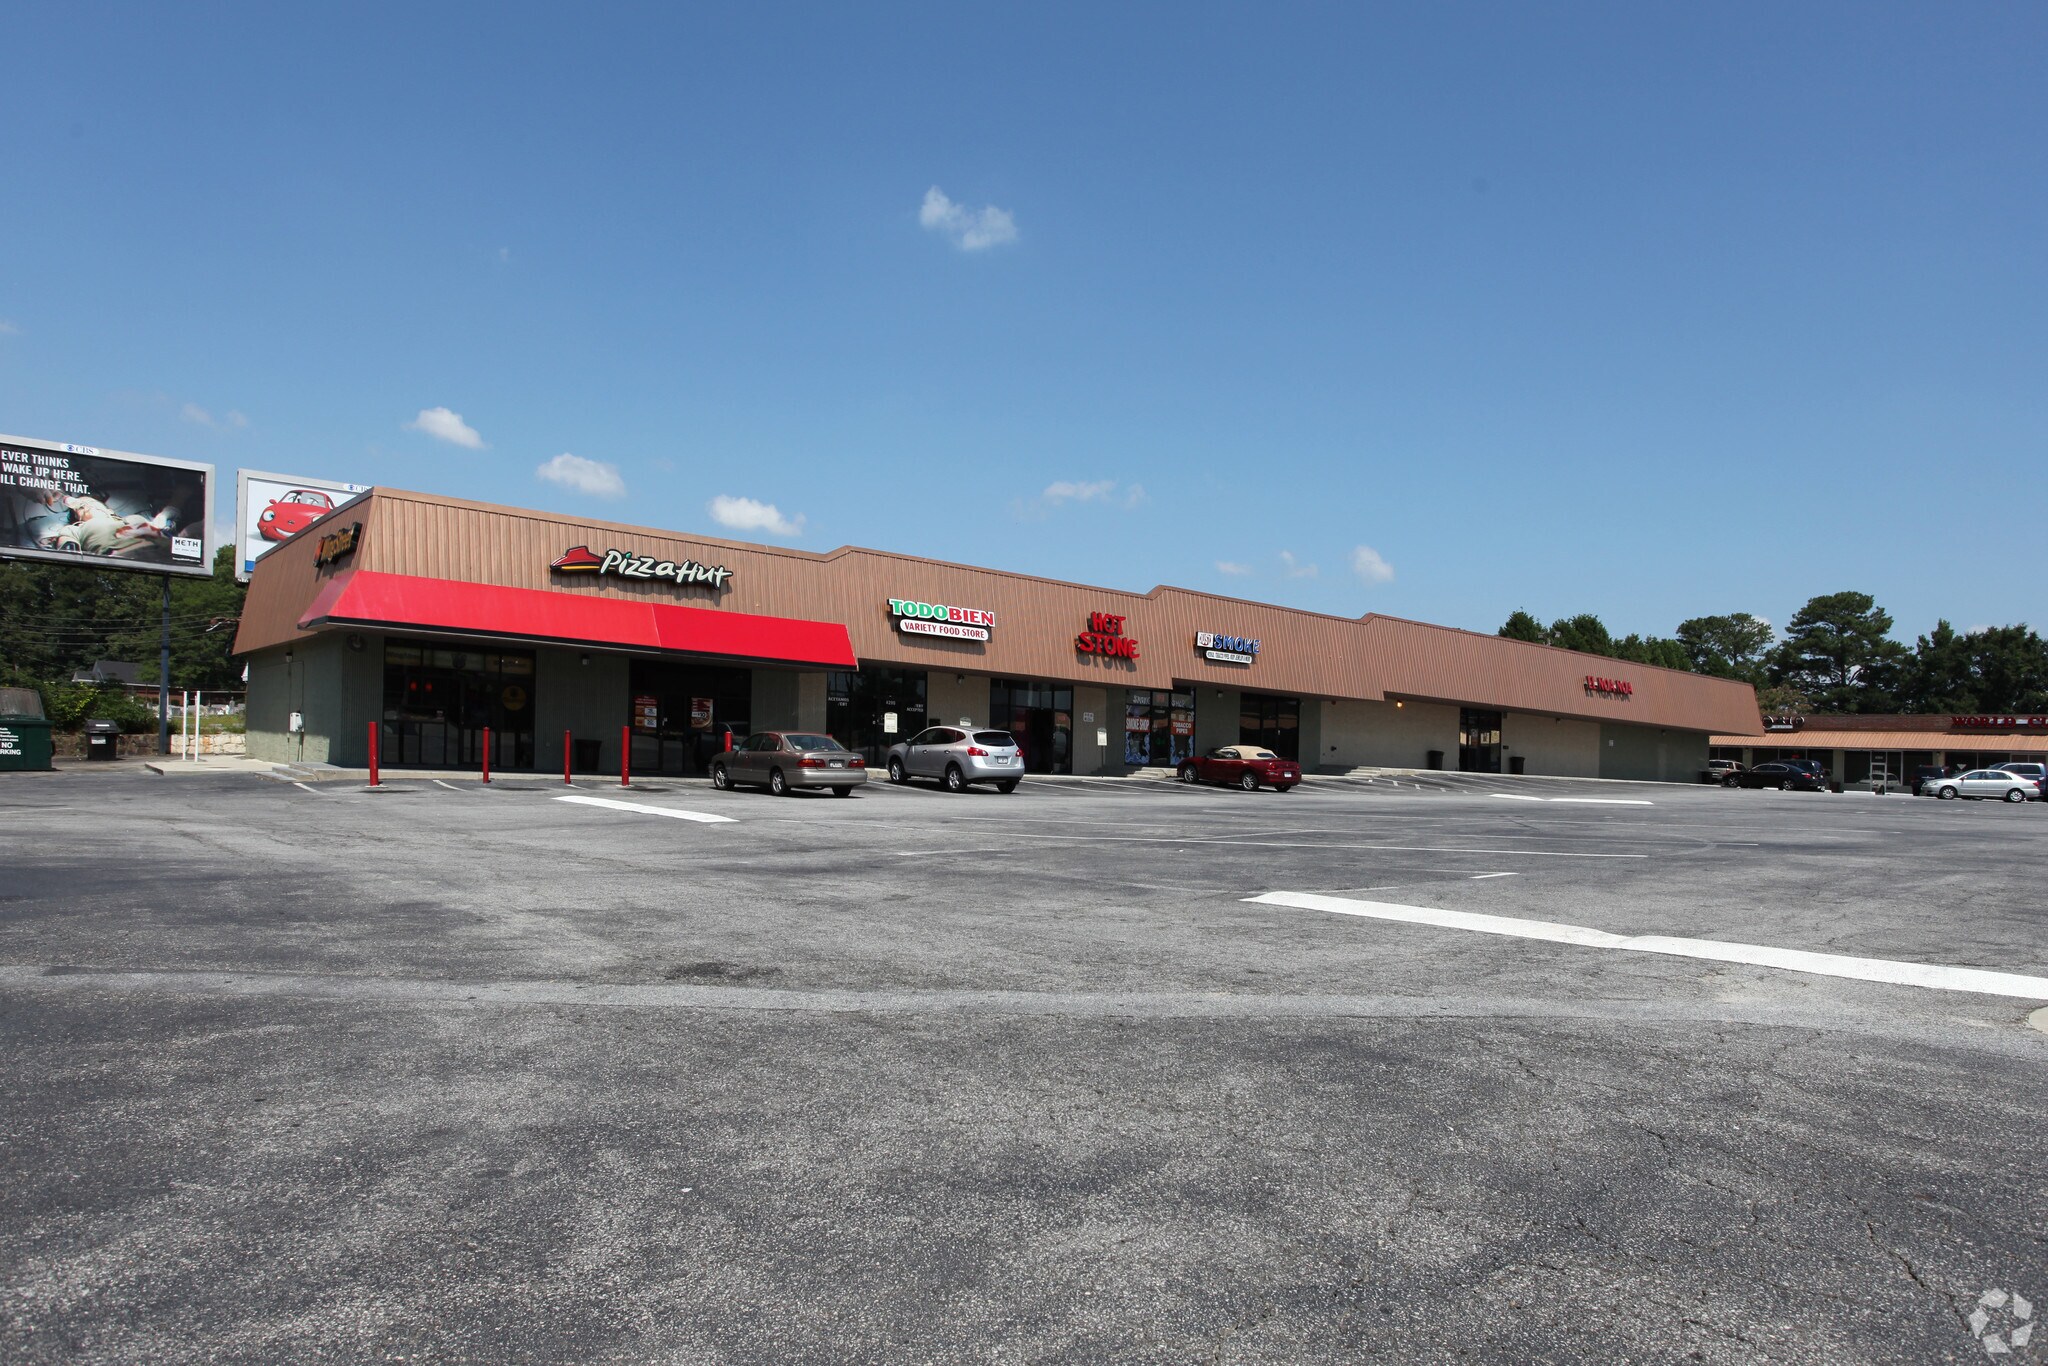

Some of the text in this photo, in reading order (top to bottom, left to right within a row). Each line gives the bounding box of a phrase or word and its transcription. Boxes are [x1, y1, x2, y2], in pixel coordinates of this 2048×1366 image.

[1, 450, 69, 469] EVER THINKS
[75, 445, 94, 455] CBS
[2, 462, 83, 482] WAKE UP HERE.
[19, 476, 61, 491] CHANGE
[64, 482, 91, 495] THAT.
[175, 539, 199, 548] METH
[600, 550, 733, 588] Pizza Hut
[904, 621, 985, 639] VARIETY FOOD STORE
[1090, 611, 1126, 635] HOT
[1079, 631, 1140, 659] STONE
[1214, 633, 1261, 654] SMOKE
[1951, 716, 2016, 729] WORLD
